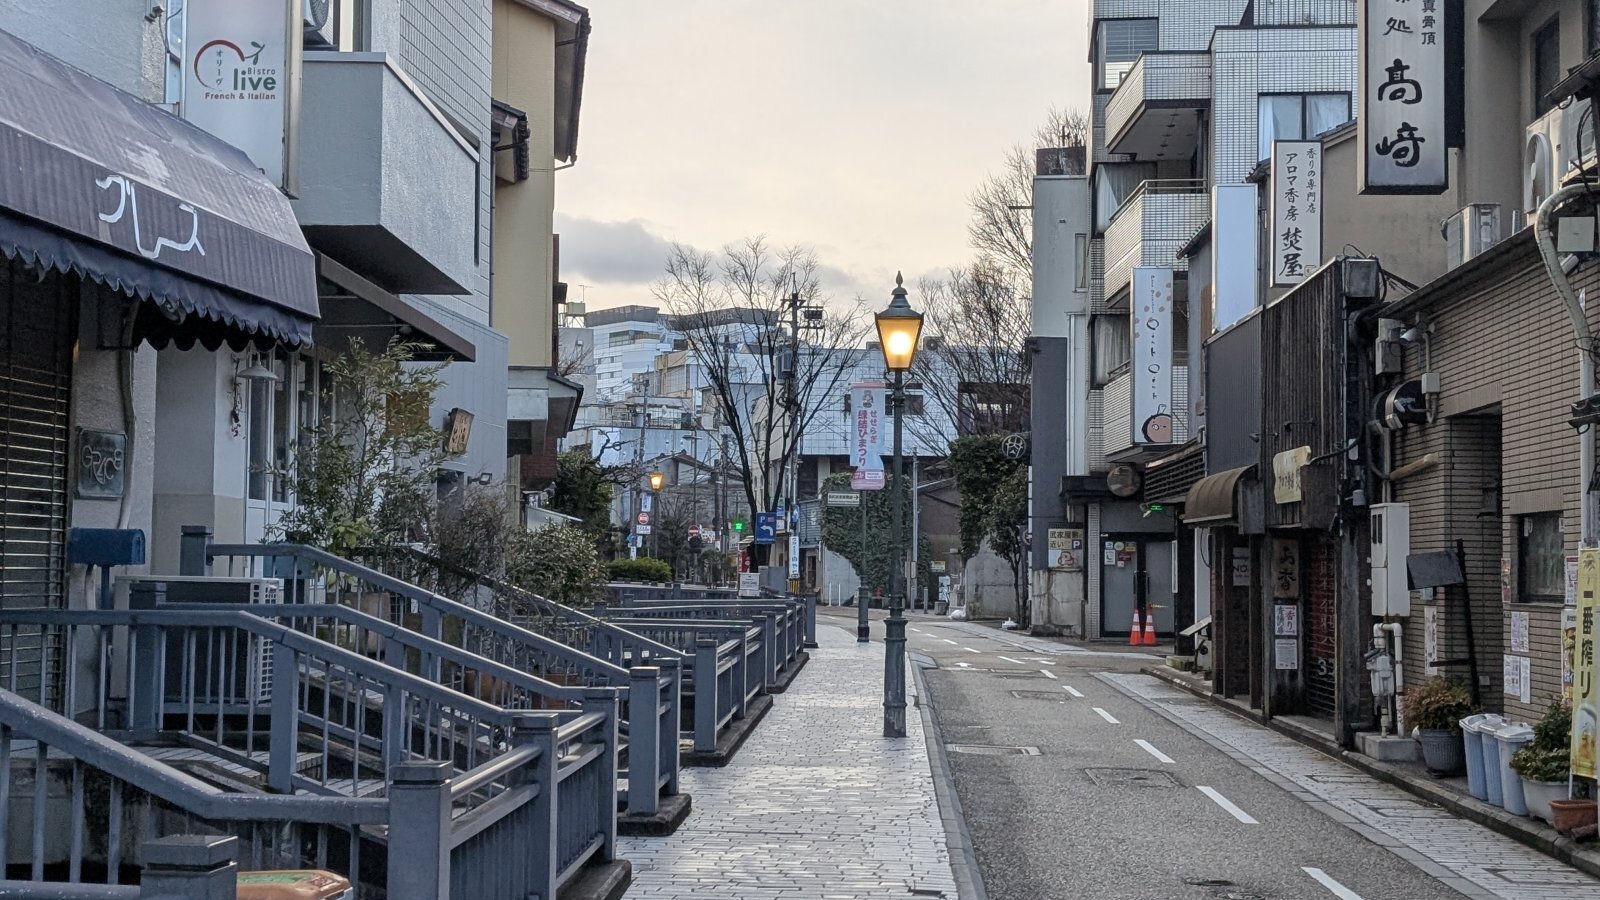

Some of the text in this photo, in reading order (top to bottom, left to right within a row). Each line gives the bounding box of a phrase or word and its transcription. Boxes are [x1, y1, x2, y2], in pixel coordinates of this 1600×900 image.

[247, 67, 276, 75] Bistro
[205, 92, 276, 100] French & Italian
[1305, 148, 1317, 214] 香りの専門店
[1284, 152, 1300, 222] アロマ香房
[760, 516, 766, 524] P
[1073, 540, 1081, 549] P
[1580, 590, 1594, 699] 一番搾り
